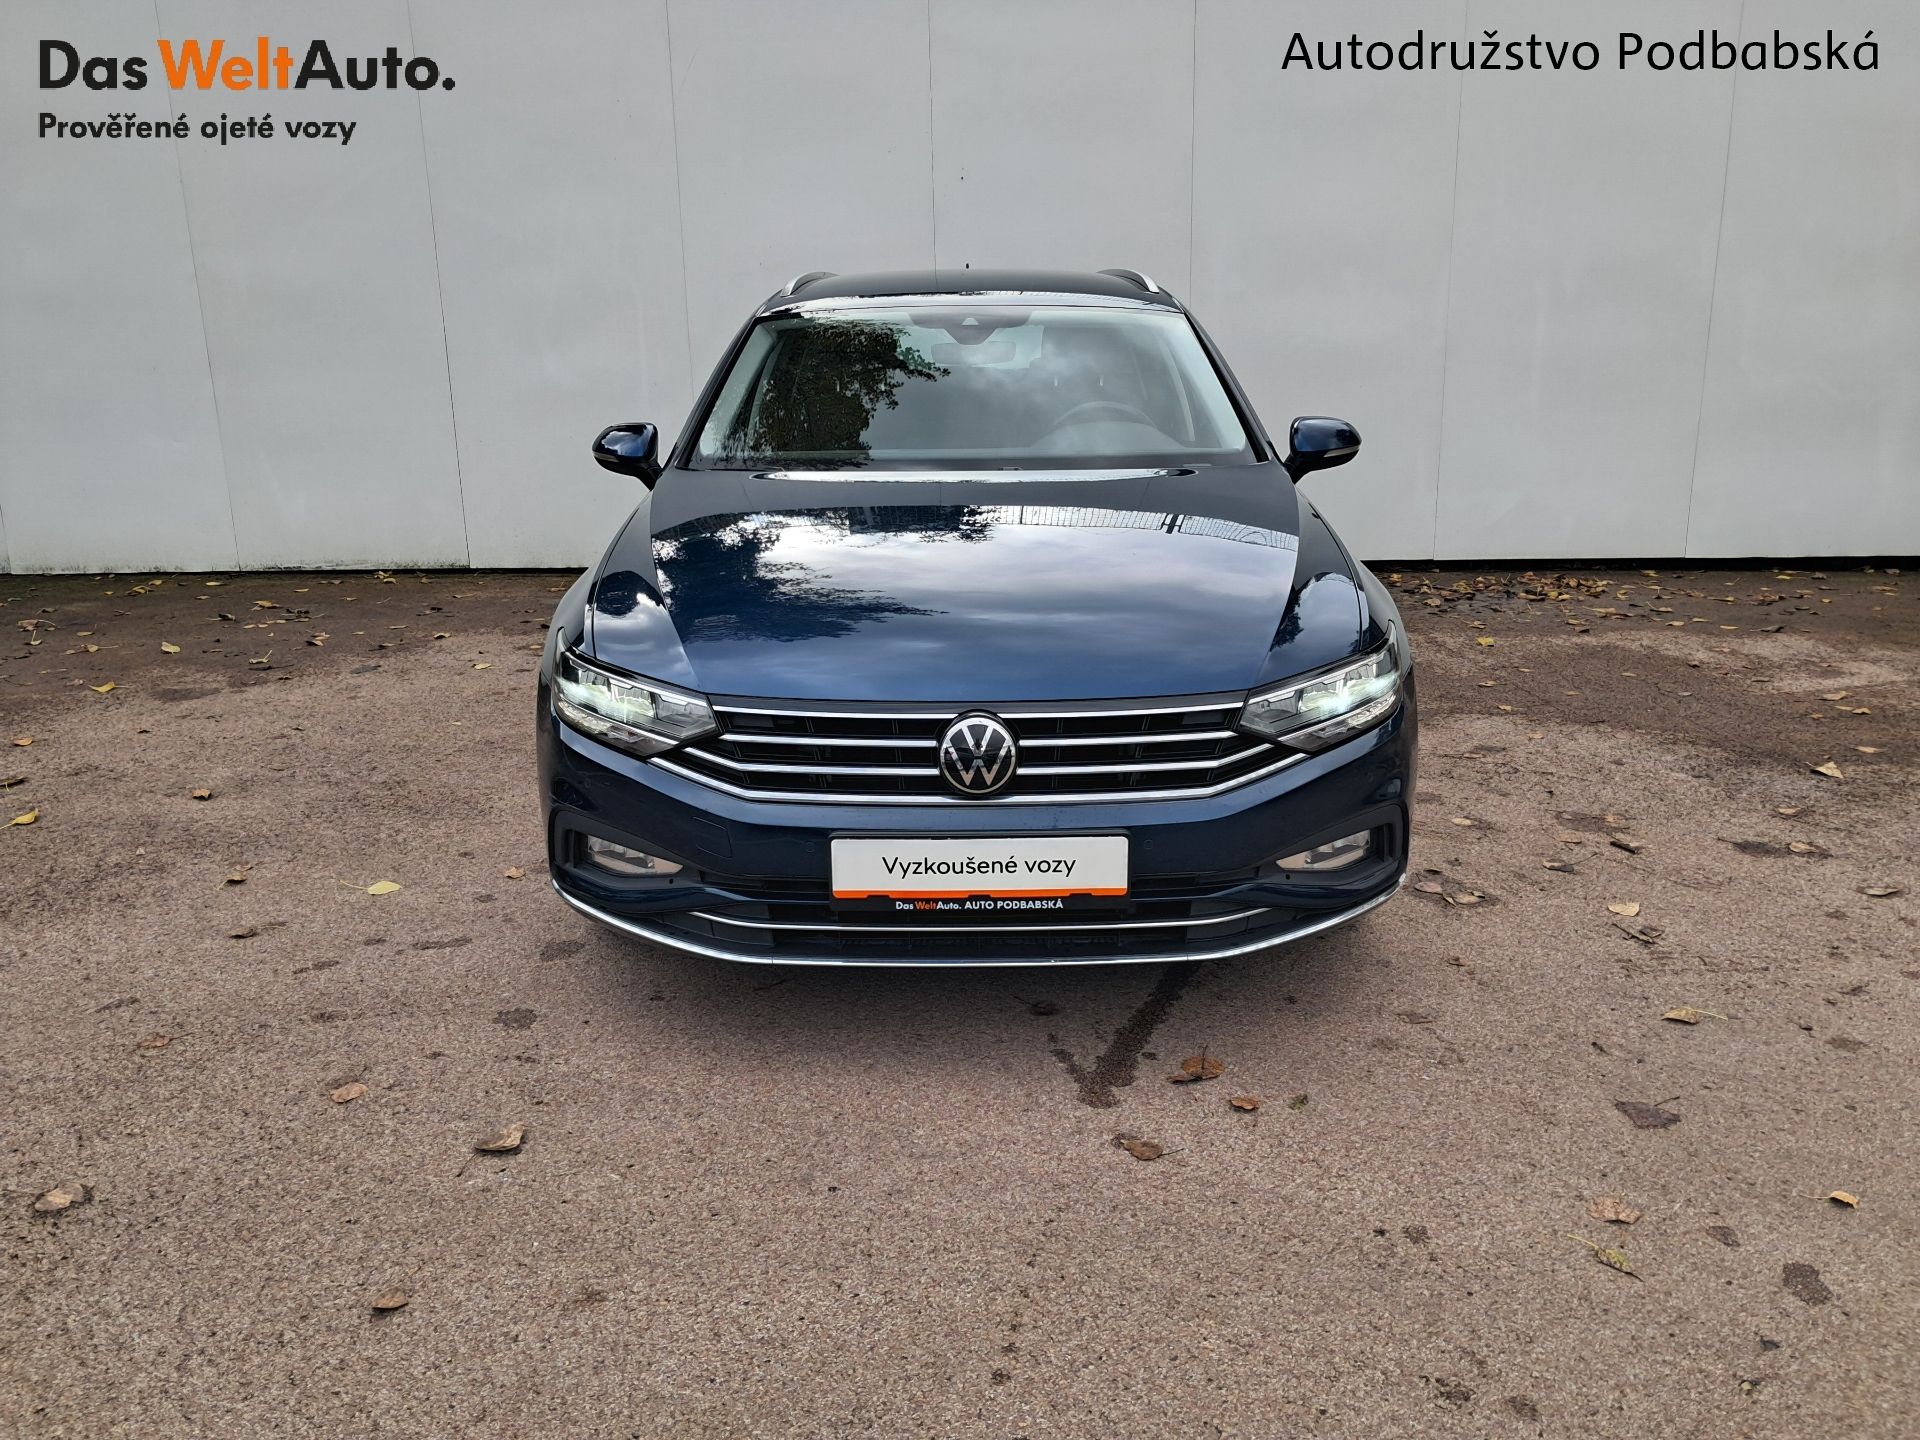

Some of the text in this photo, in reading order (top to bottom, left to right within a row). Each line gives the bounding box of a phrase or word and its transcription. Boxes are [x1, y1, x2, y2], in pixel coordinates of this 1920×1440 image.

[881, 856, 1077, 880] Vyzkoušené vozy
[895, 901, 914, 910] Das
[964, 900, 994, 910] AUTO
[996, 898, 1064, 910] PODBABSKÁ
